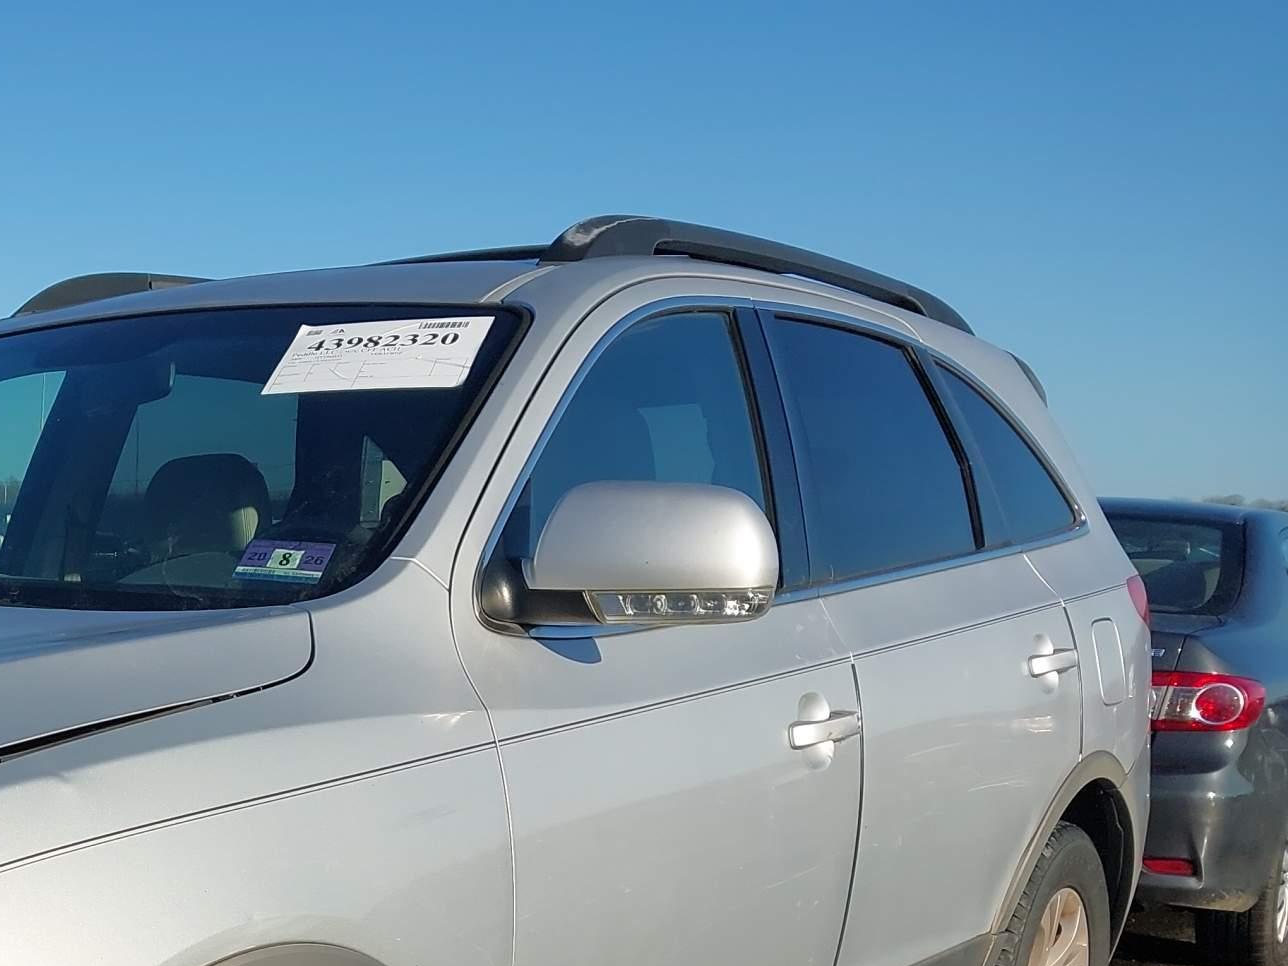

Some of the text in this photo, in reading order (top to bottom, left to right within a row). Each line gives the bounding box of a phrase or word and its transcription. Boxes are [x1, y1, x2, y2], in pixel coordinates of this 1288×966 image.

[307, 332, 460, 352] 43982320
[248, 552, 324, 566] 20 8 26
